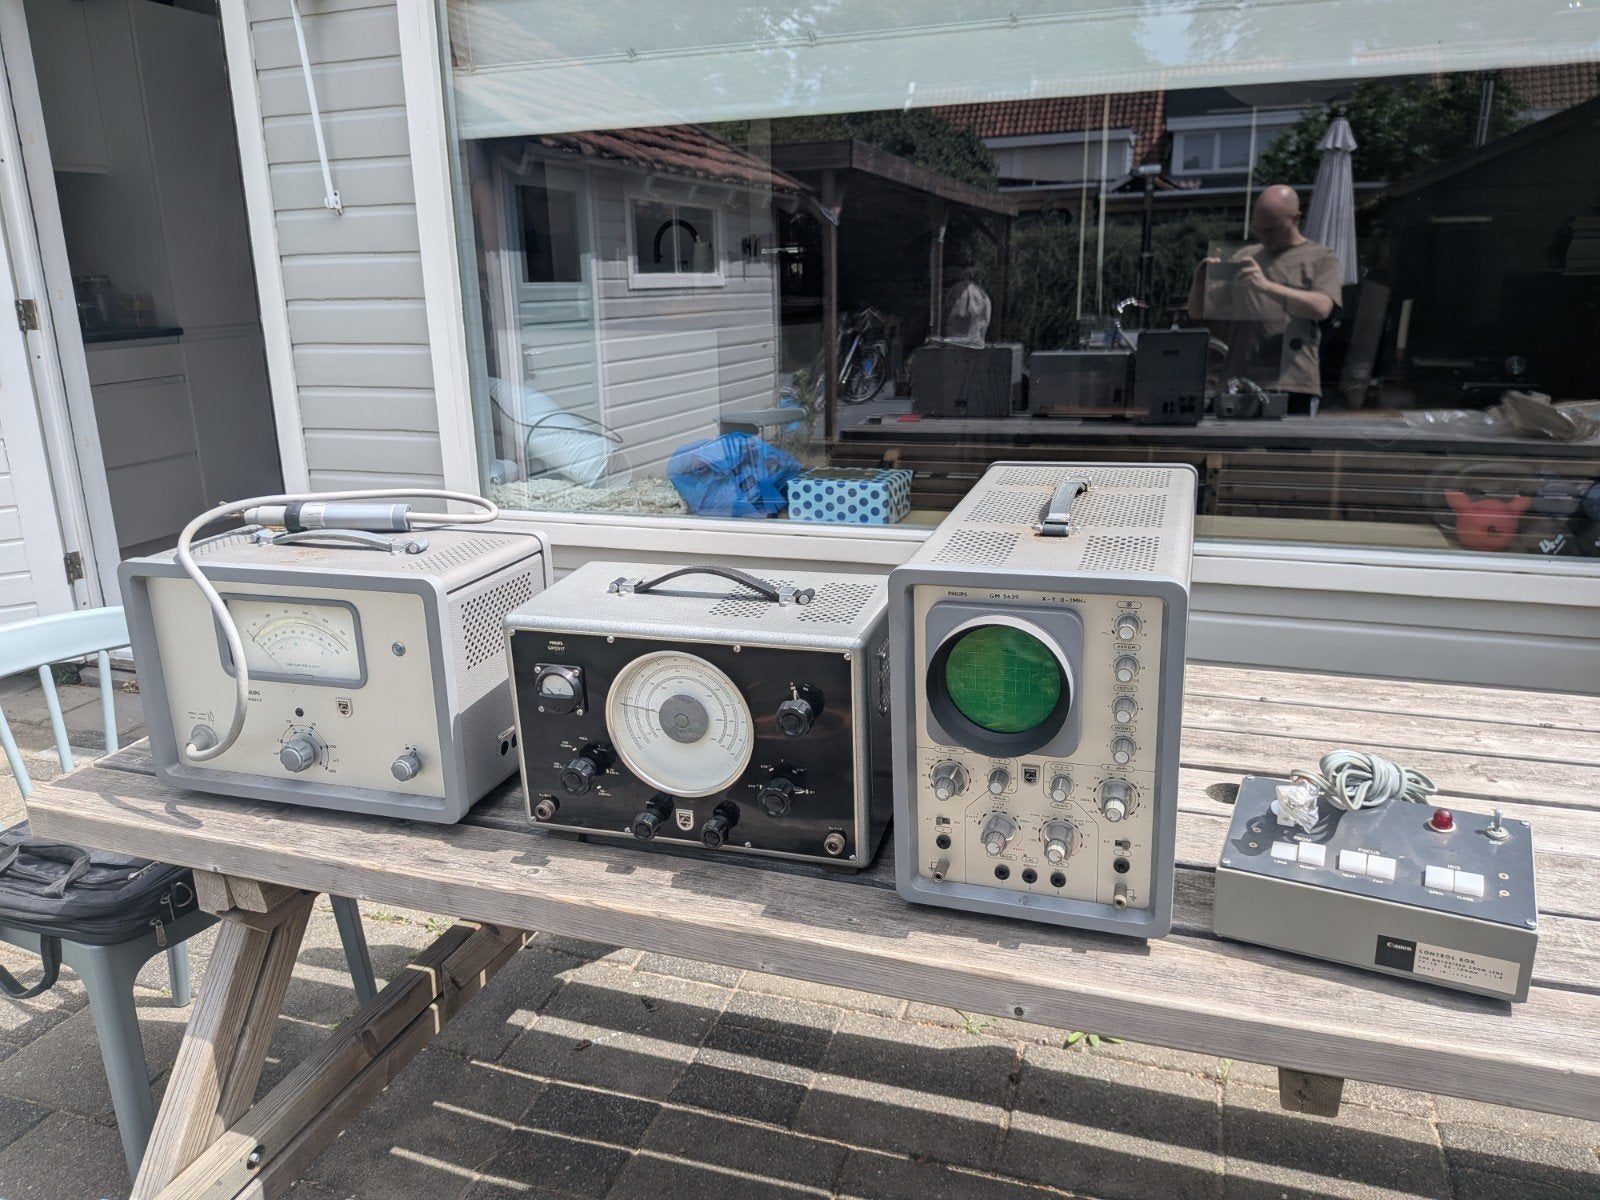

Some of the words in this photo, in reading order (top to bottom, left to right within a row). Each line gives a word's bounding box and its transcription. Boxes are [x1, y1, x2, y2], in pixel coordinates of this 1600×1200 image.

[1293, 835, 1313, 843] ZOOM
[1357, 847, 1381, 856] FOCUS
[1386, 941, 1413, 952] Canon
[1418, 949, 1455, 961] CONTROL
[1459, 957, 1476, 965] BOX
[1468, 965, 1487, 973] ZOOM
